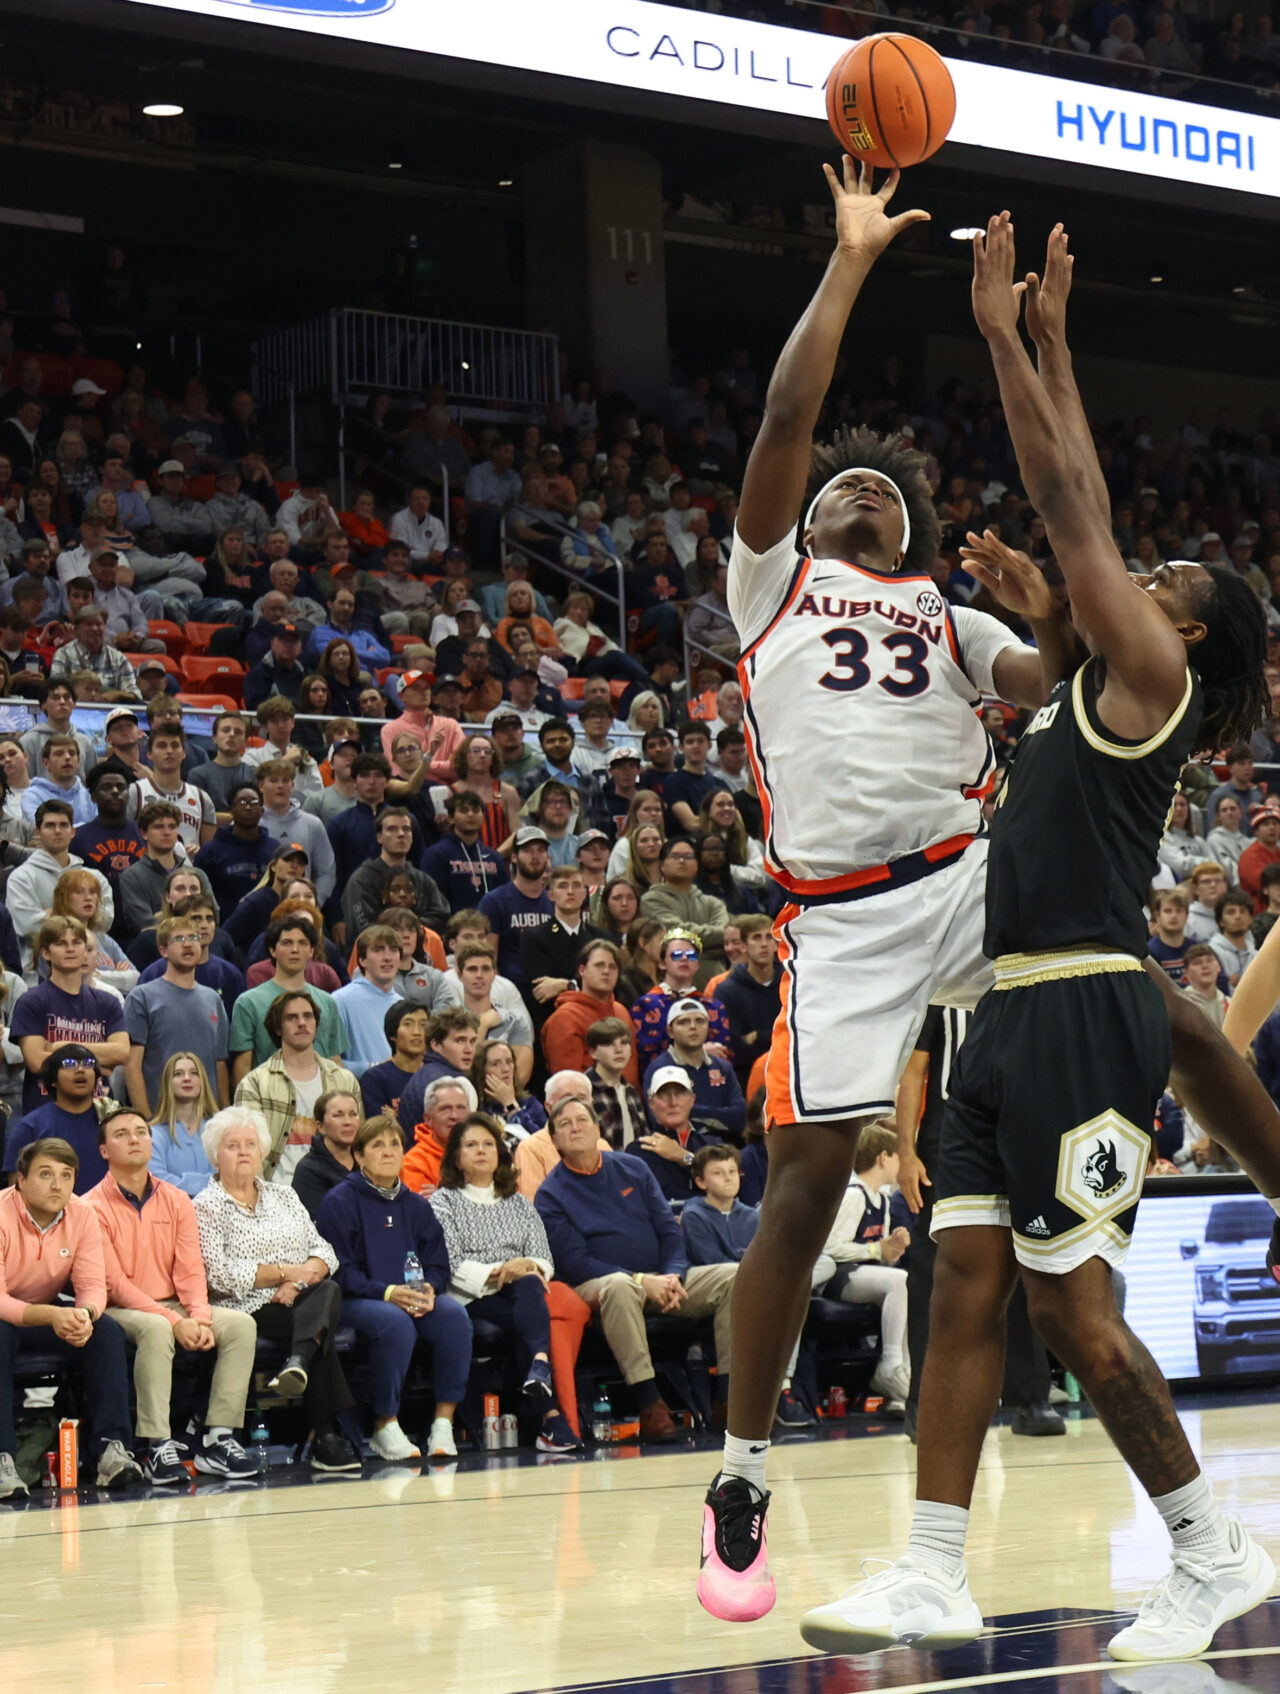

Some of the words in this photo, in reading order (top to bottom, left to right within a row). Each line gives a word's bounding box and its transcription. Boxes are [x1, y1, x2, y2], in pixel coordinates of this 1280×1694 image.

[606, 26, 827, 91] CADILL
[842, 84, 870, 150] ELITE
[1056, 100, 1255, 172] HYUNDAI
[606, 226, 652, 264] 111
[793, 593, 943, 646] AUBURN
[918, 593, 942, 615] SEC
[818, 627, 931, 698] 33
[1025, 1225, 1051, 1235] adidas
